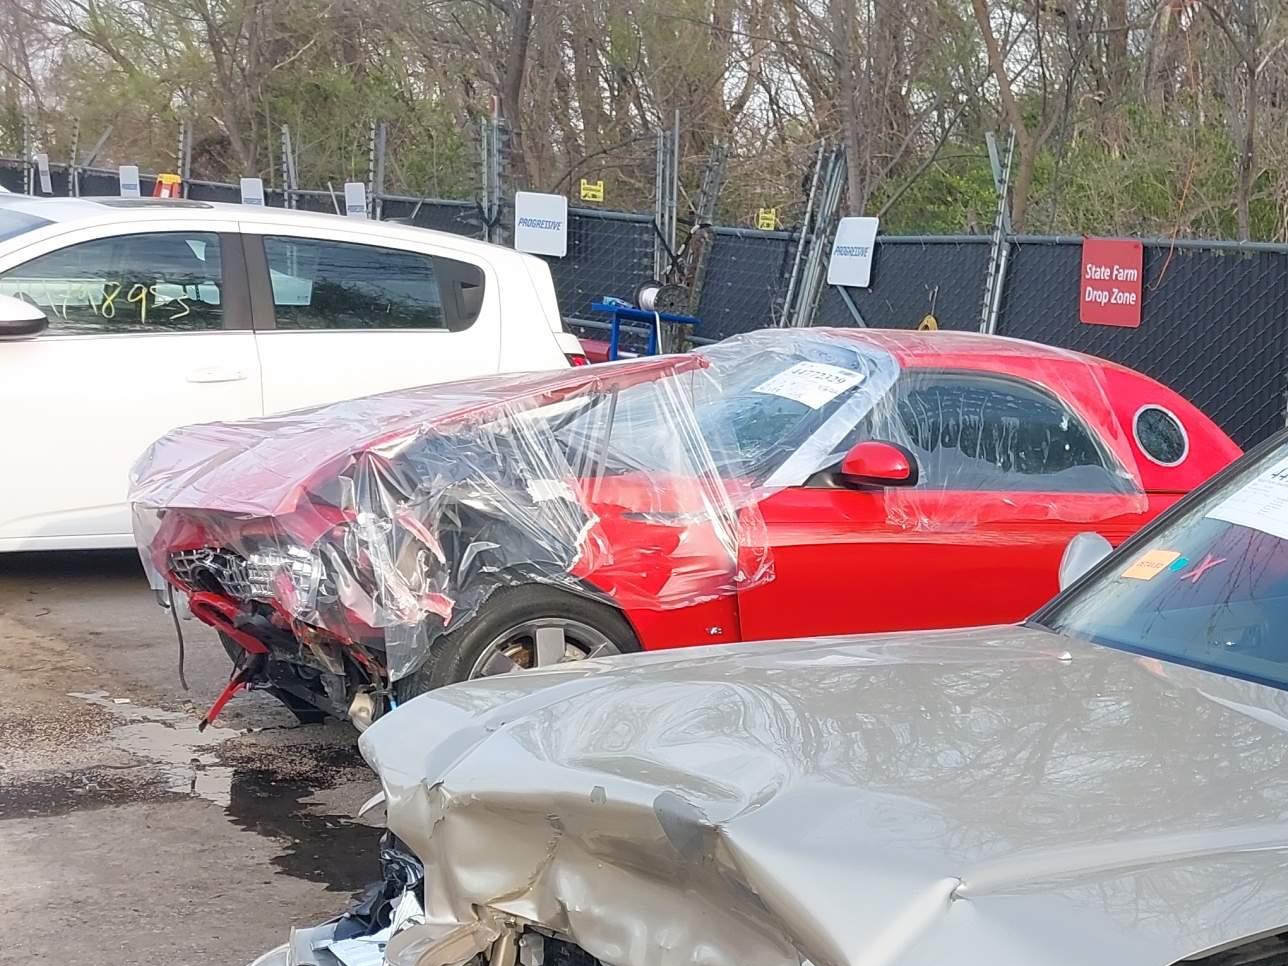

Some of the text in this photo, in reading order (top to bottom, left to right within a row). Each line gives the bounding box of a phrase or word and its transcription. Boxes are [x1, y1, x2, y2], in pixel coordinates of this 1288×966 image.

[518, 217, 562, 231] PROGRESSIVE
[1085, 264, 1138, 282] State Farm
[1085, 286, 1136, 307] Drop Zone
